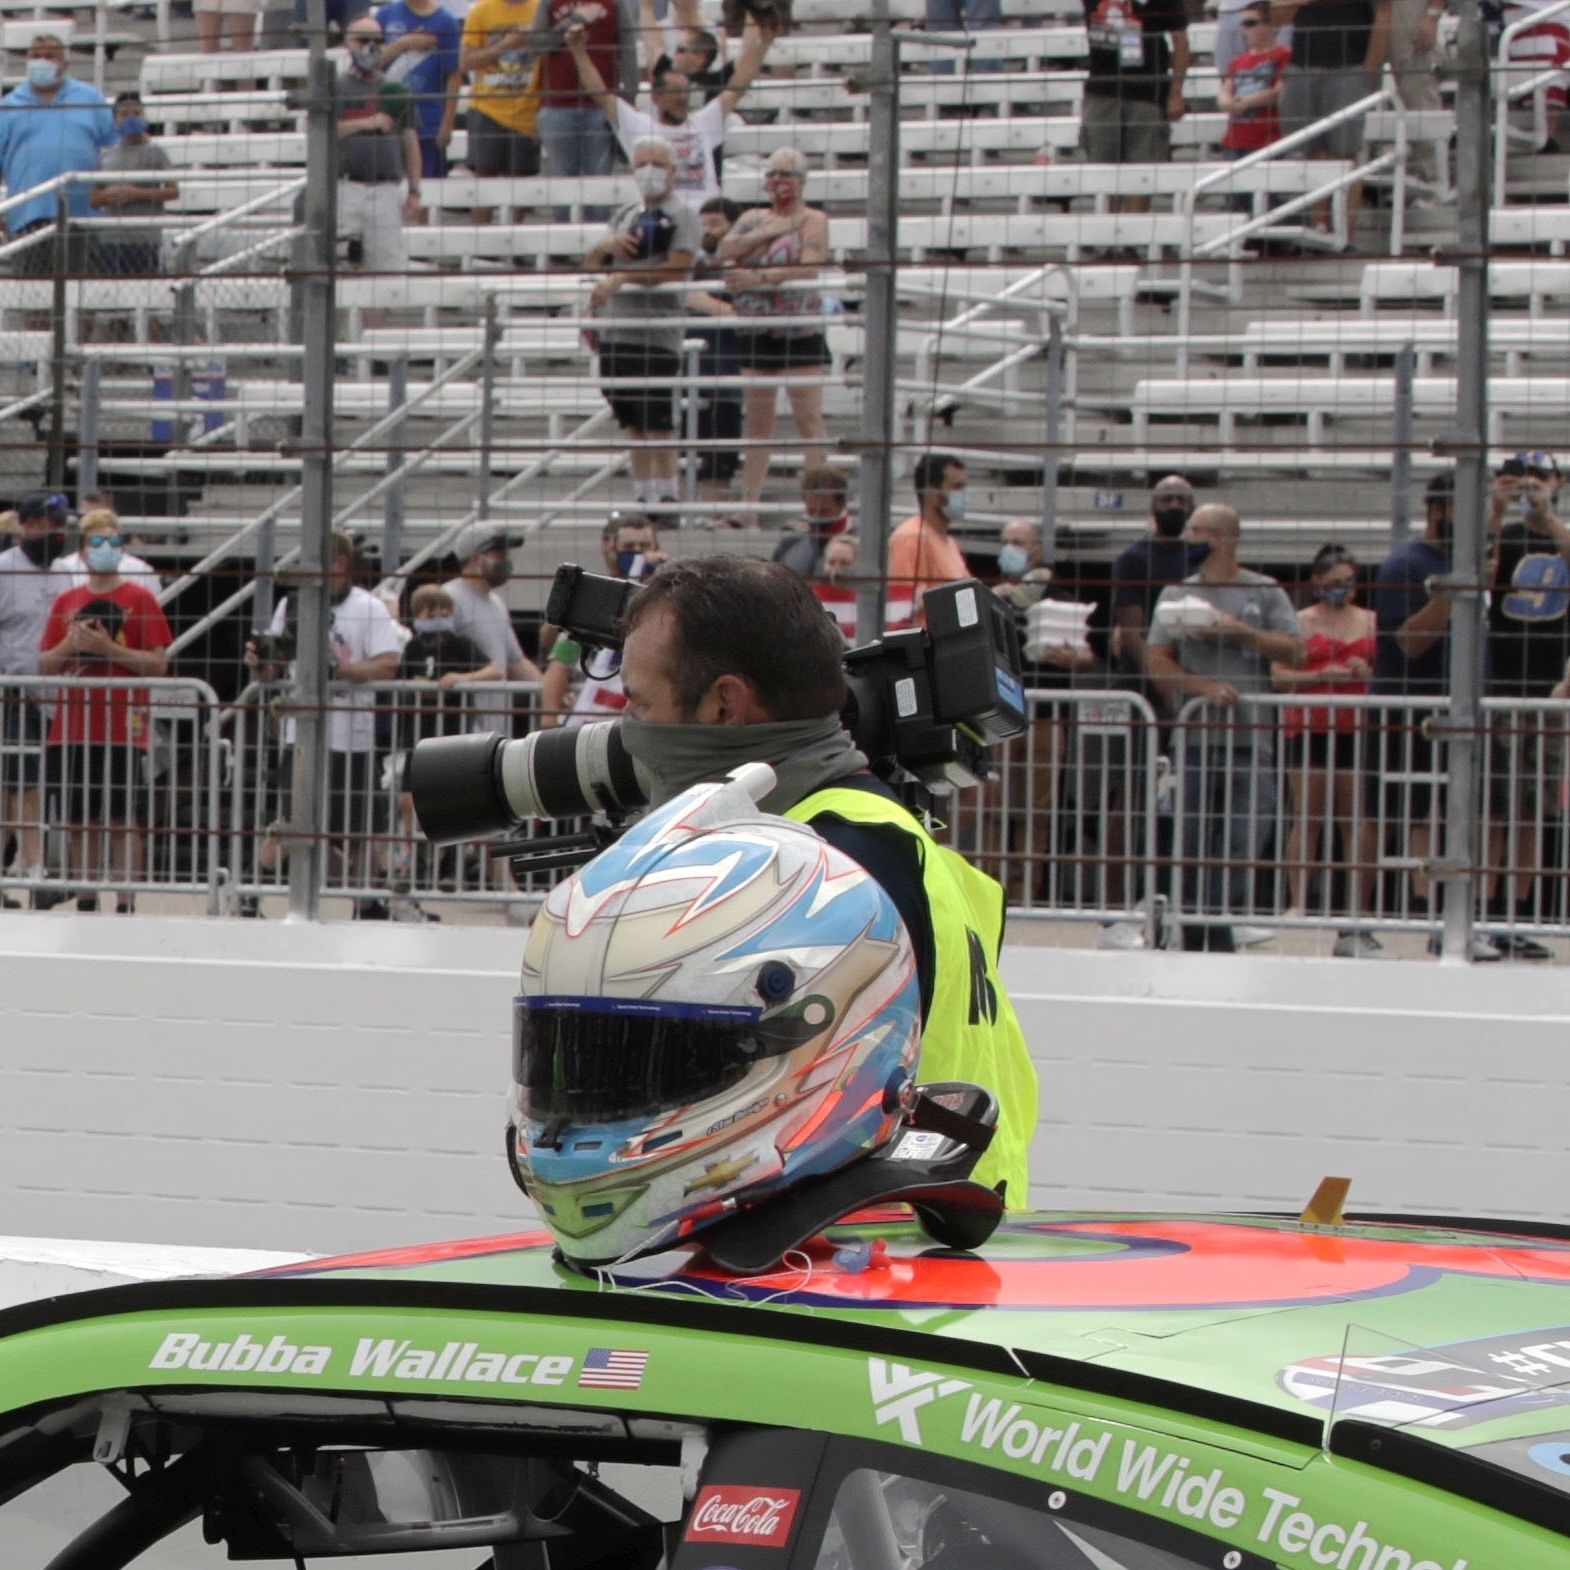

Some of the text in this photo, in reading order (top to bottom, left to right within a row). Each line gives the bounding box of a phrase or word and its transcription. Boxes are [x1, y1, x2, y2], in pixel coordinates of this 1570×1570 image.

[148, 1332, 574, 1386] Bubba Wallace
[960, 1392, 1103, 1485] World
[1113, 1439, 1250, 1530] Wide
[692, 1493, 790, 1537] Coca-Cola
